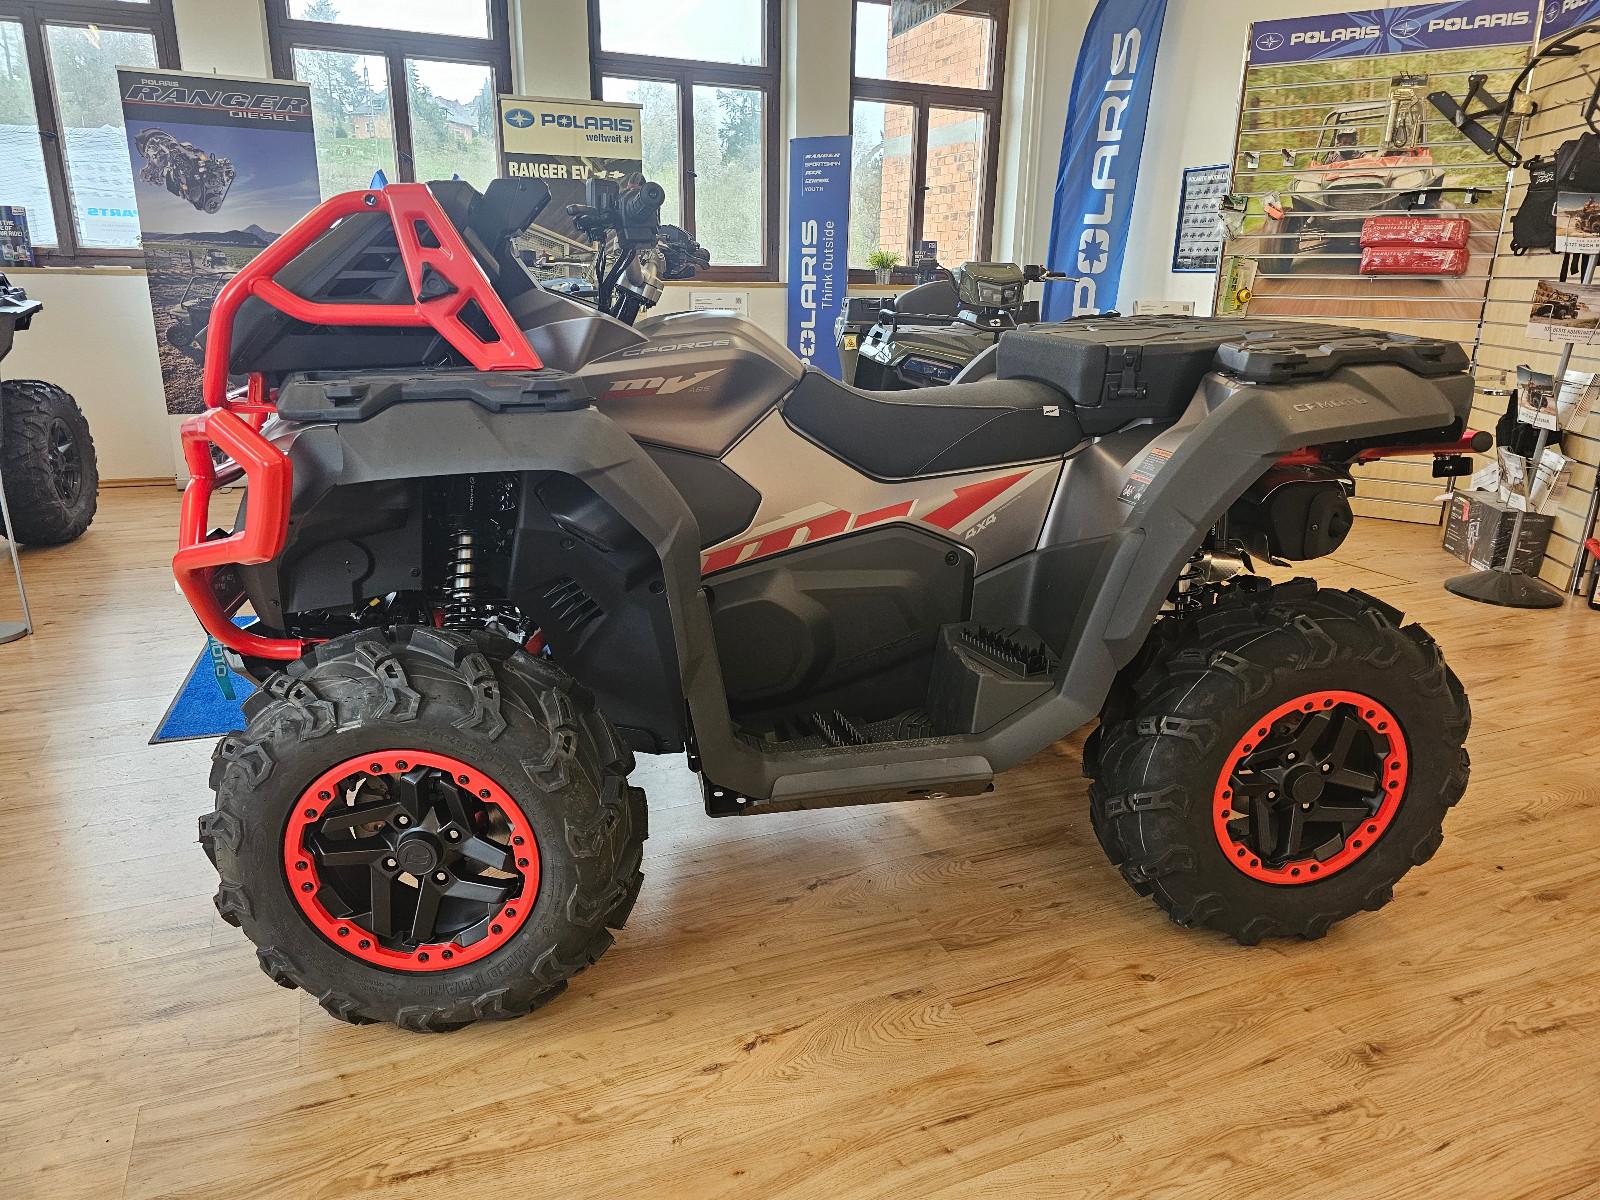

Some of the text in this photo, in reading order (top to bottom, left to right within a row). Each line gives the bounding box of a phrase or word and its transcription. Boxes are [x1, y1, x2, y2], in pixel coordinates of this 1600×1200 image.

[1428, 11, 1530, 32] POLARIS
[1290, 25, 1380, 45] POLARIS
[142, 79, 179, 87] POLARIS
[125, 85, 309, 112] RANGER
[229, 111, 297, 122] DIESEL
[541, 113, 633, 132] POLARIS
[586, 134, 633, 144] weltweit #1
[508, 161, 589, 180] RANGER EV
[1072, 28, 1141, 317] POLARIS
[821, 221, 835, 310] Think Outside
[621, 339, 730, 357] CFORCE
